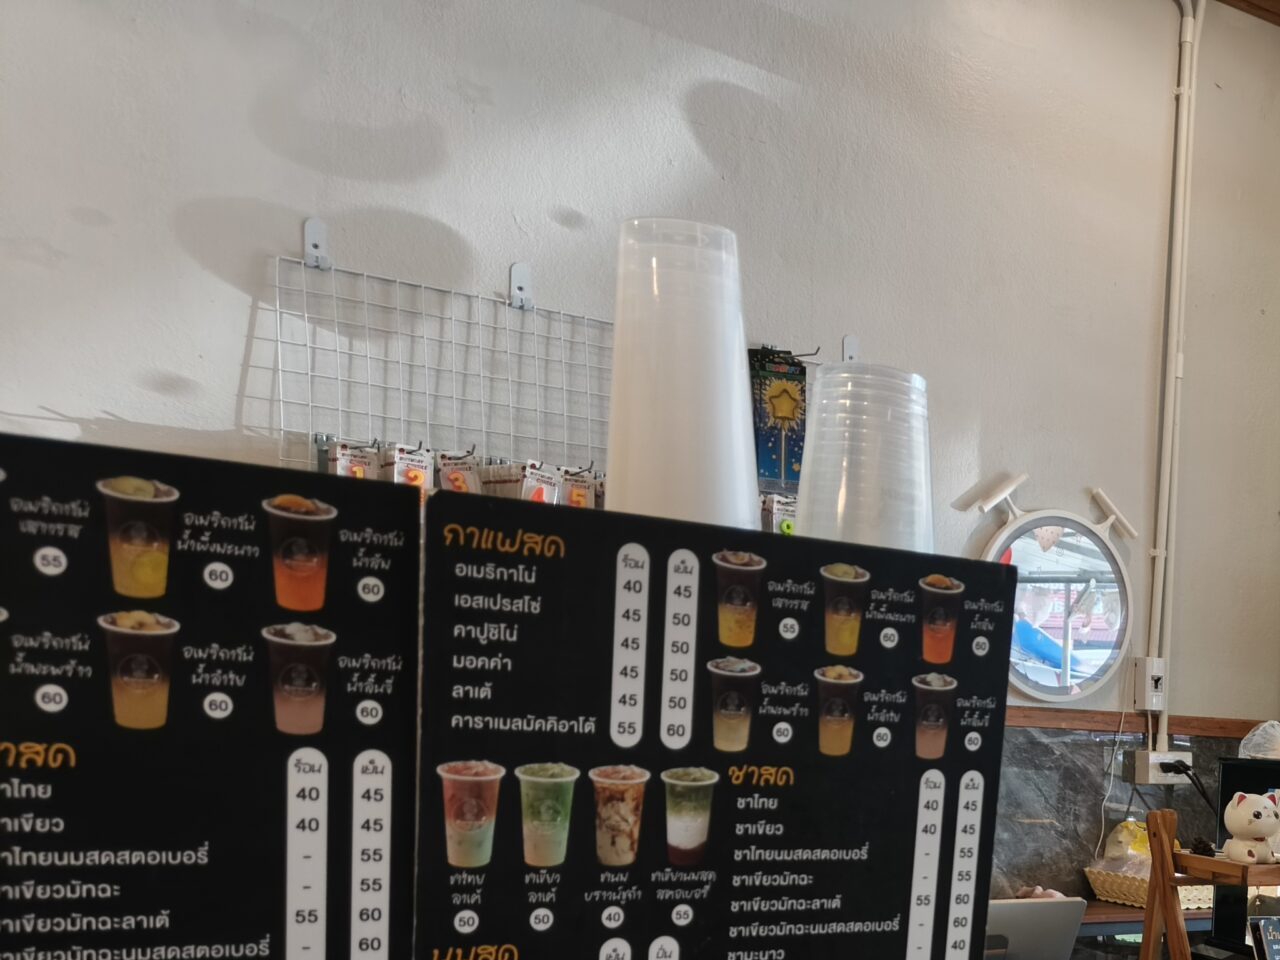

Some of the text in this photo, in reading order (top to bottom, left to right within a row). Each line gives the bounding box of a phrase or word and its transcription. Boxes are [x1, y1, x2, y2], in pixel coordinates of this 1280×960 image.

[444, 524, 565, 557] กาแฟสด
[41, 554, 62, 568] 55
[208, 569, 229, 582] 60
[455, 563, 536, 583] อเมริกาโน่
[362, 583, 380, 595] 60
[623, 580, 691, 598] 40 45
[455, 594, 541, 613] เอสเปรสโซ่
[622, 609, 690, 626] 45 50
[454, 623, 518, 644] คาปูชิโน่
[783, 624, 795, 633] 55
[883, 633, 895, 642] 60
[621, 637, 689, 654] 45 50
[453, 653, 511, 670] มอคค่า
[620, 666, 688, 682] 45 50
[452, 682, 492, 699] ลาเต้
[41, 692, 63, 704] 60
[619, 694, 686, 709] 45 50
[208, 700, 228, 711] 60
[360, 707, 379, 718] 60
[452, 715, 596, 733] คาราเมลมัคคิอาโต้
[618, 722, 685, 737] 55 60
[776, 728, 789, 737] 60
[876, 733, 888, 741] 60
[968, 737, 979, 746] 60
[0, 742, 76, 768] าสด
[729, 765, 794, 786] ชาสด
[0, 778, 51, 798] าไทย
[296, 787, 384, 801] 40 45
[737, 794, 778, 809] ชาไทย
[924, 800, 977, 811] 40 45
[0, 813, 64, 832] าเขียว
[296, 818, 383, 832] 40 45
[736, 820, 783, 835] ชาเขียว
[922, 824, 975, 835] 40 45
[0, 842, 208, 866] าไทยนมสดสตอเบอรี่
[361, 849, 382, 862] 55
[734, 842, 869, 861] ชาไทยนมสดสตอเบอรี่
[960, 848, 973, 858] 55
[733, 871, 813, 886] ชาเขียวมัทฉะ
[958, 871, 971, 881] 55
[0, 880, 120, 899] าเขียวมัทฉะ
[360, 878, 382, 892] 55
[731, 895, 841, 912] ชาเขียวมัทฉะลาเต้
[916, 894, 969, 906] 55 60
[0, 910, 170, 932] าเขียวมัทฉะลาเต้
[296, 908, 381, 923] 55 60
[459, 917, 475, 927] 50
[534, 914, 549, 924] 50
[606, 912, 620, 922] 40
[676, 911, 689, 920] 55
[953, 917, 967, 928] 60
[729, 914, 900, 937] ชาเขียวมัทฉะนมสดสตอเบอรี่
[359, 937, 381, 951] 60
[951, 940, 965, 950] 40
